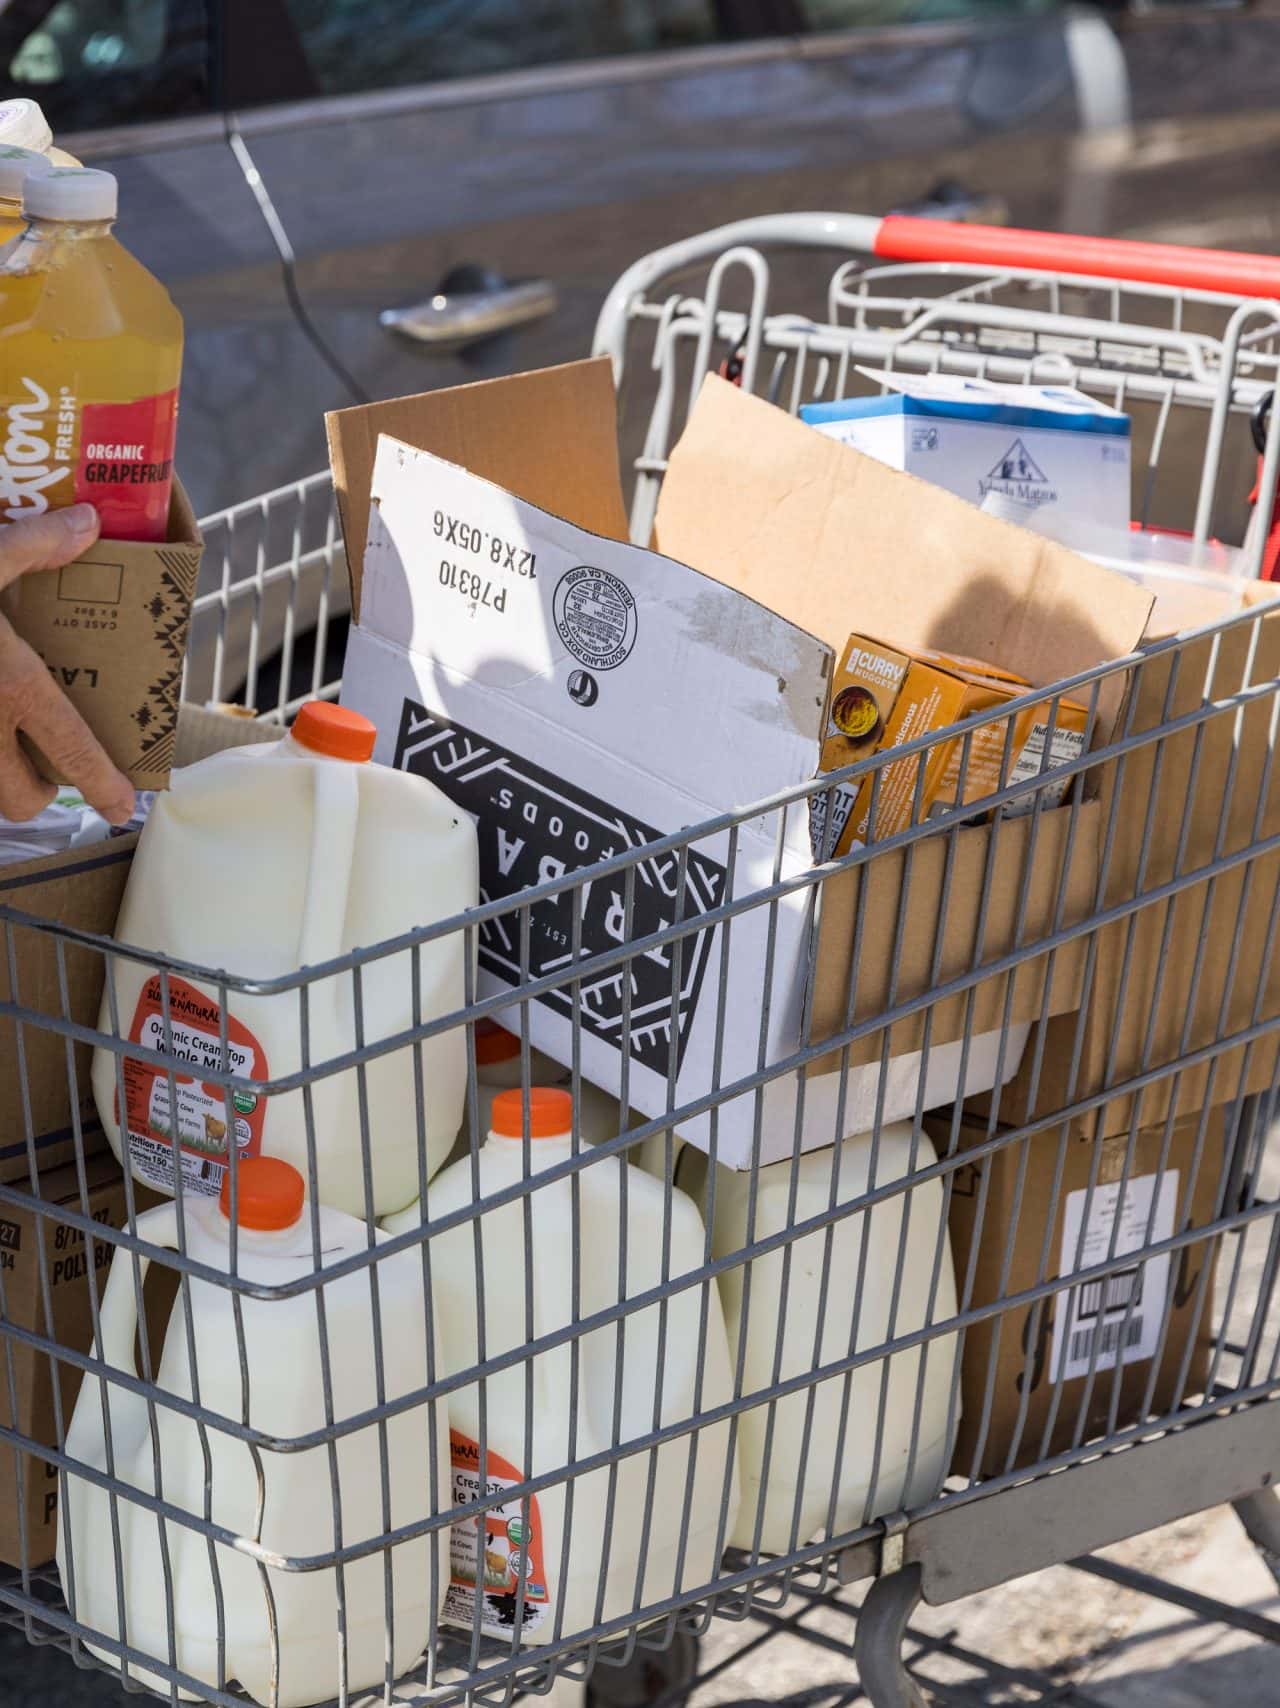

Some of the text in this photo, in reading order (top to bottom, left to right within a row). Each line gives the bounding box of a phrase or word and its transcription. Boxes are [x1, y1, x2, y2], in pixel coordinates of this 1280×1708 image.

[86, 443, 145, 461] ORGANIC
[432, 509, 538, 580] 12X8.05X6
[438, 560, 508, 614] P78310
[567, 638, 584, 657] BOX
[583, 646, 627, 667] SOUTHLAND
[858, 650, 905, 681] CURRY
[129, 1135, 156, 1150] utrition
